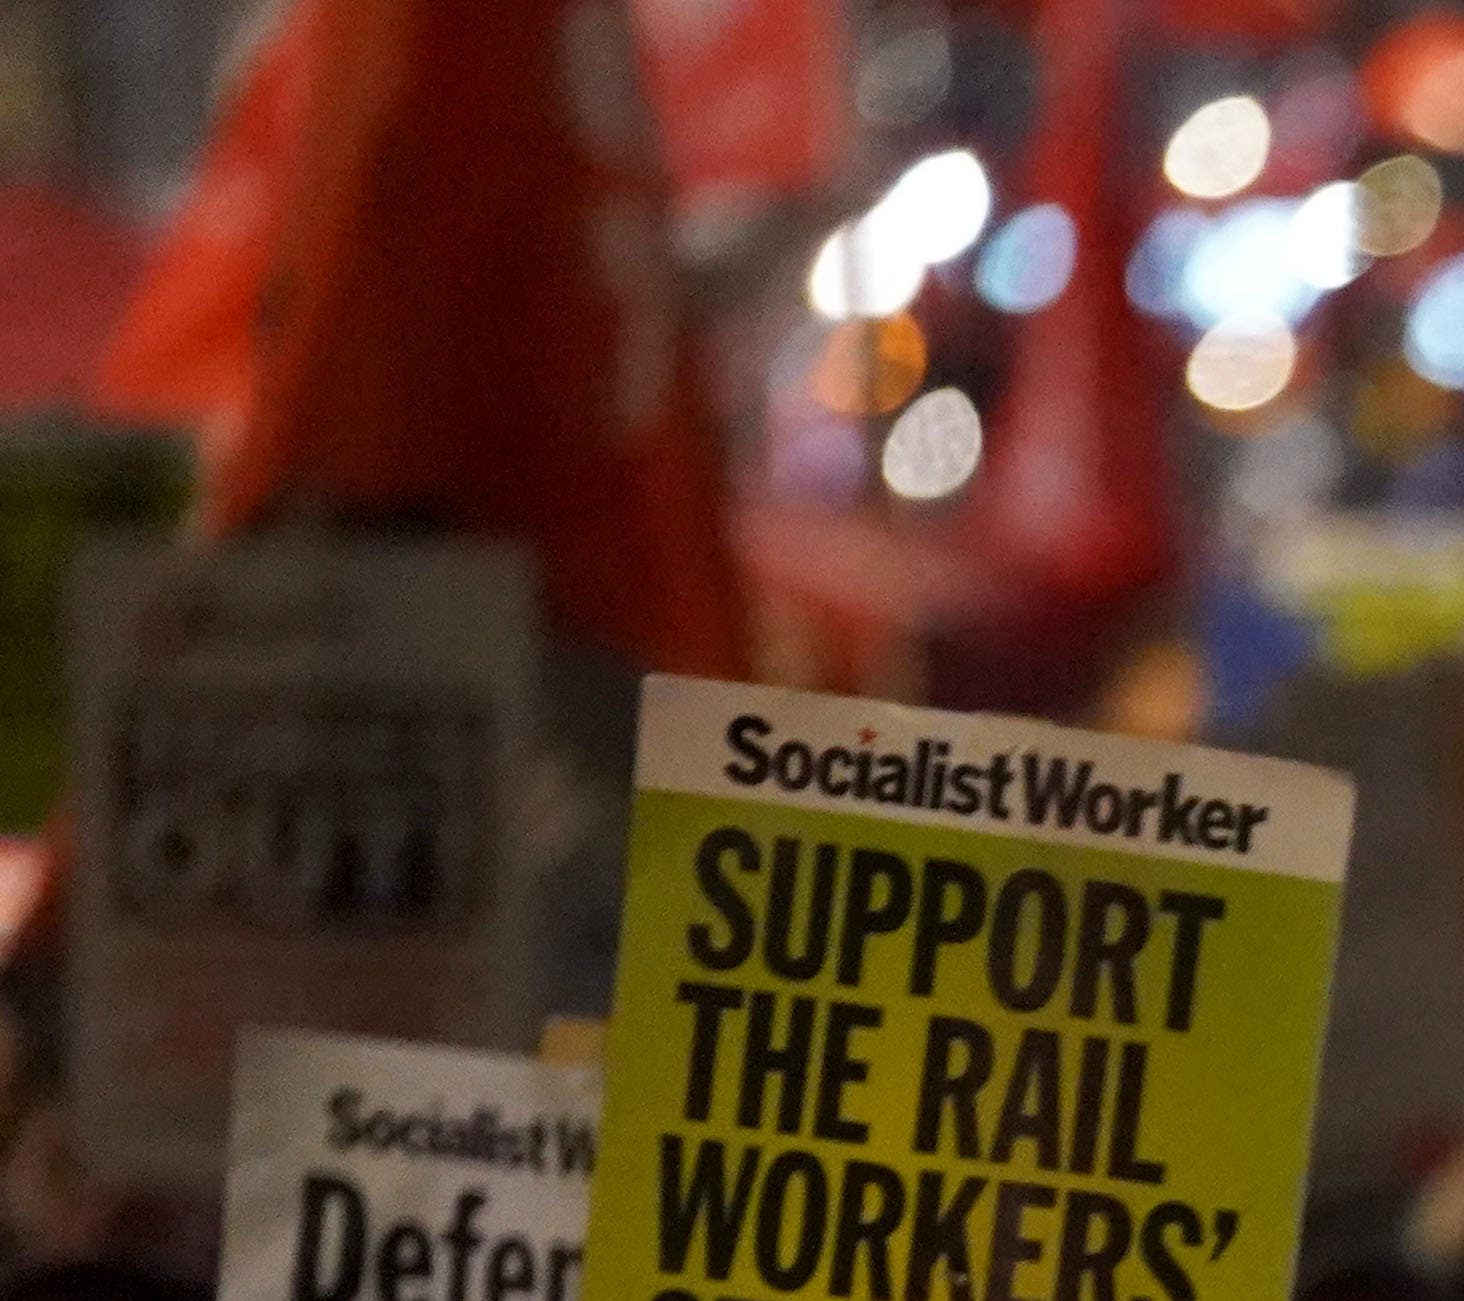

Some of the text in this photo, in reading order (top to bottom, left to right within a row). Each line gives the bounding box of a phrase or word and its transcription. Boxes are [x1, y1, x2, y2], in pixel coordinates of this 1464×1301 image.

[686, 826, 1224, 1032] SUPPORT
[676, 982, 1165, 1185] THE RAIL
